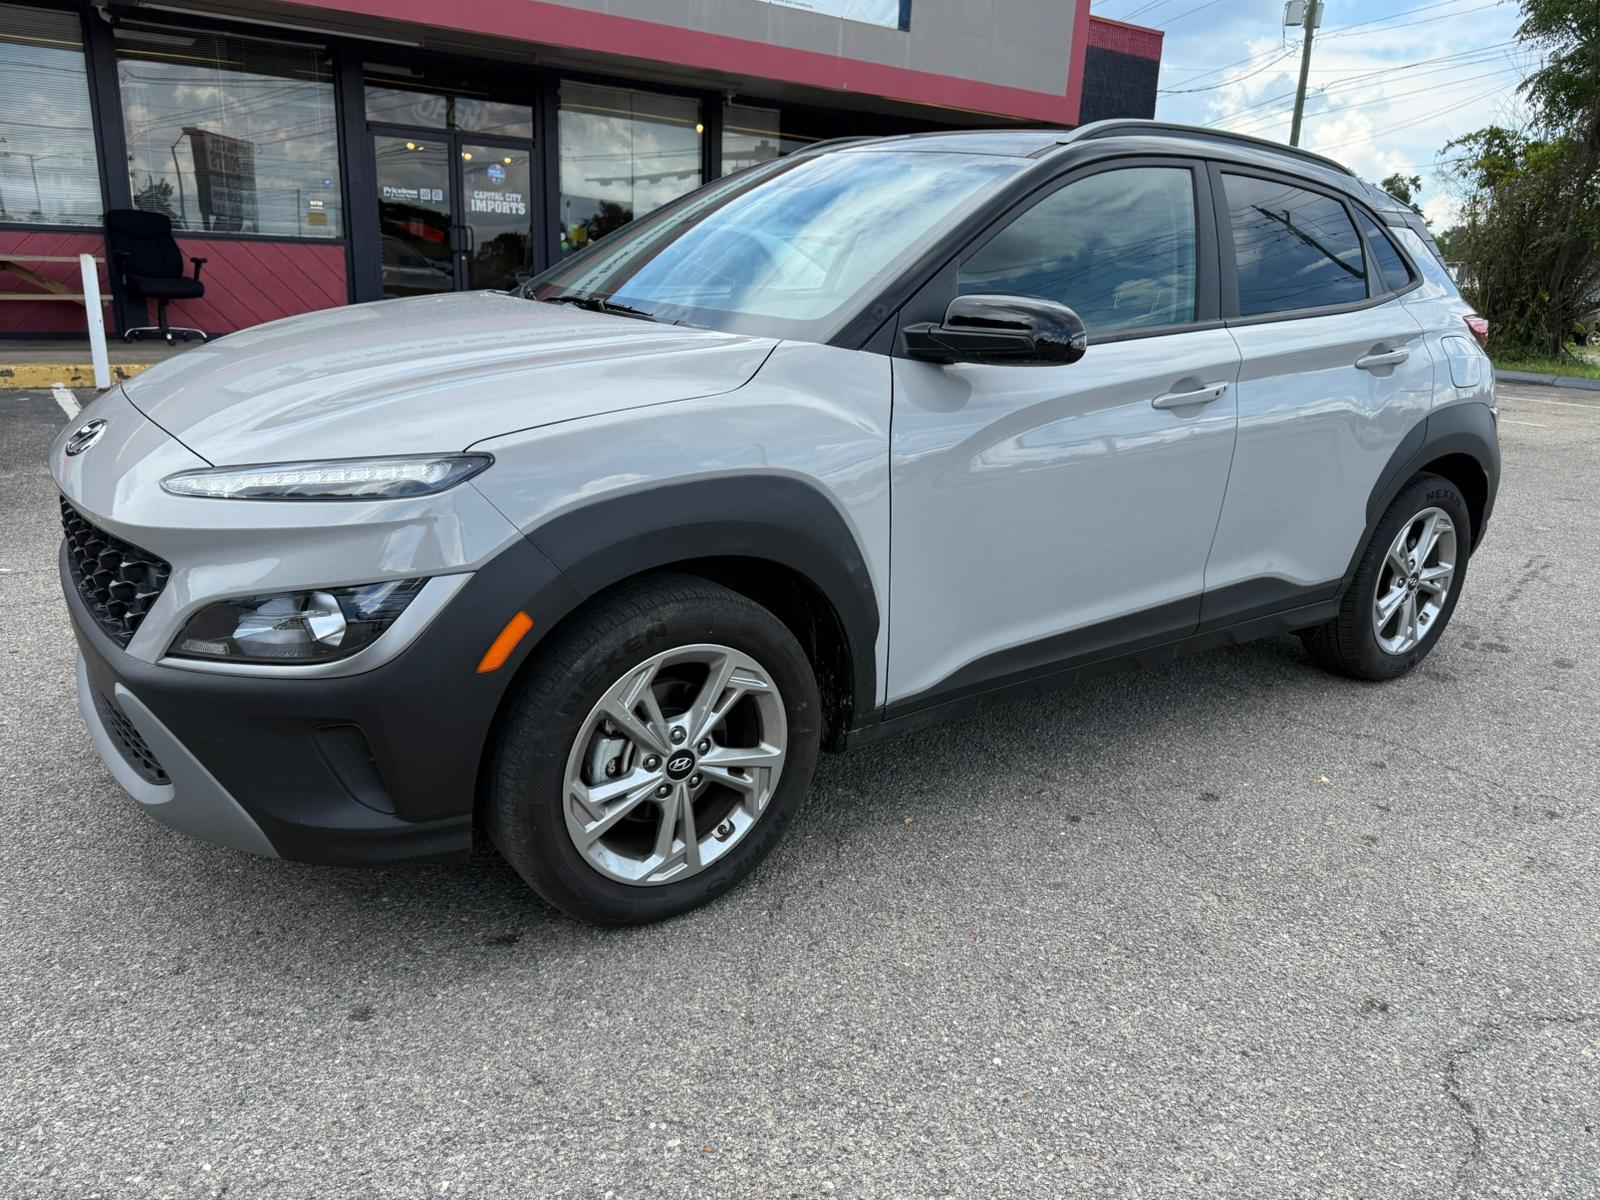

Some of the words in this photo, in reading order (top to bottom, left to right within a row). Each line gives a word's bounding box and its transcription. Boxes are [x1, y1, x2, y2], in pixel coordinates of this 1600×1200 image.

[473, 191, 503, 200] CAPITAL
[505, 193, 522, 202] CITY
[471, 199, 525, 215] IMPORTS
[1426, 489, 1460, 507] NEXEN
[561, 623, 667, 717] NEXEN
